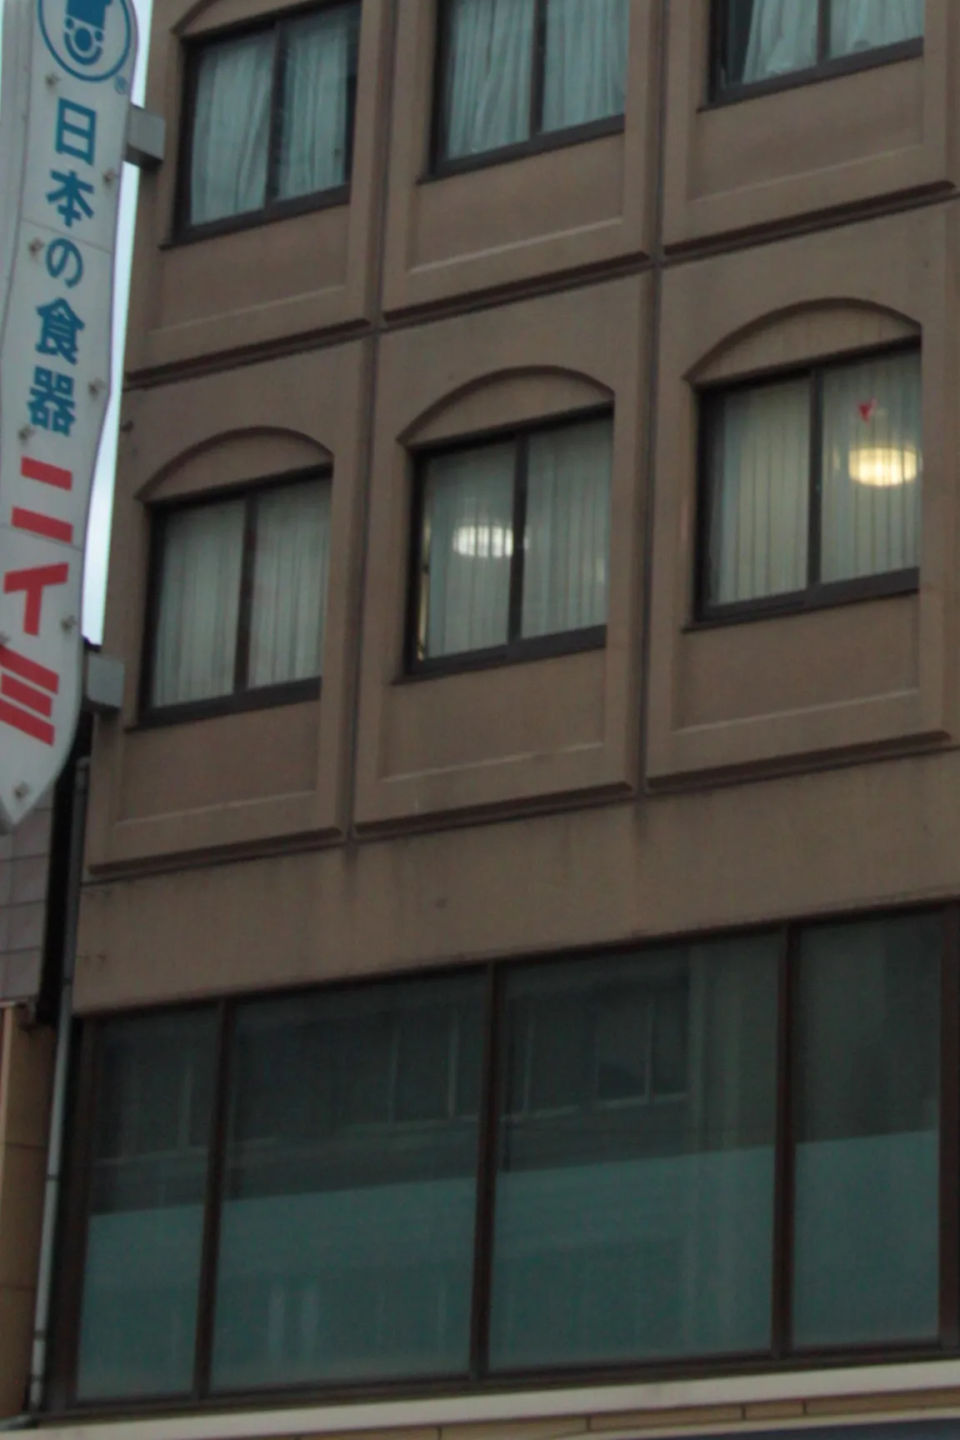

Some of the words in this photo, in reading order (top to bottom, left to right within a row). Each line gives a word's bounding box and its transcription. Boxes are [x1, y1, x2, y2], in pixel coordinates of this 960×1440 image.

[27, 97, 97, 438] 日本の食器
[0, 456, 74, 748] ニイミ
